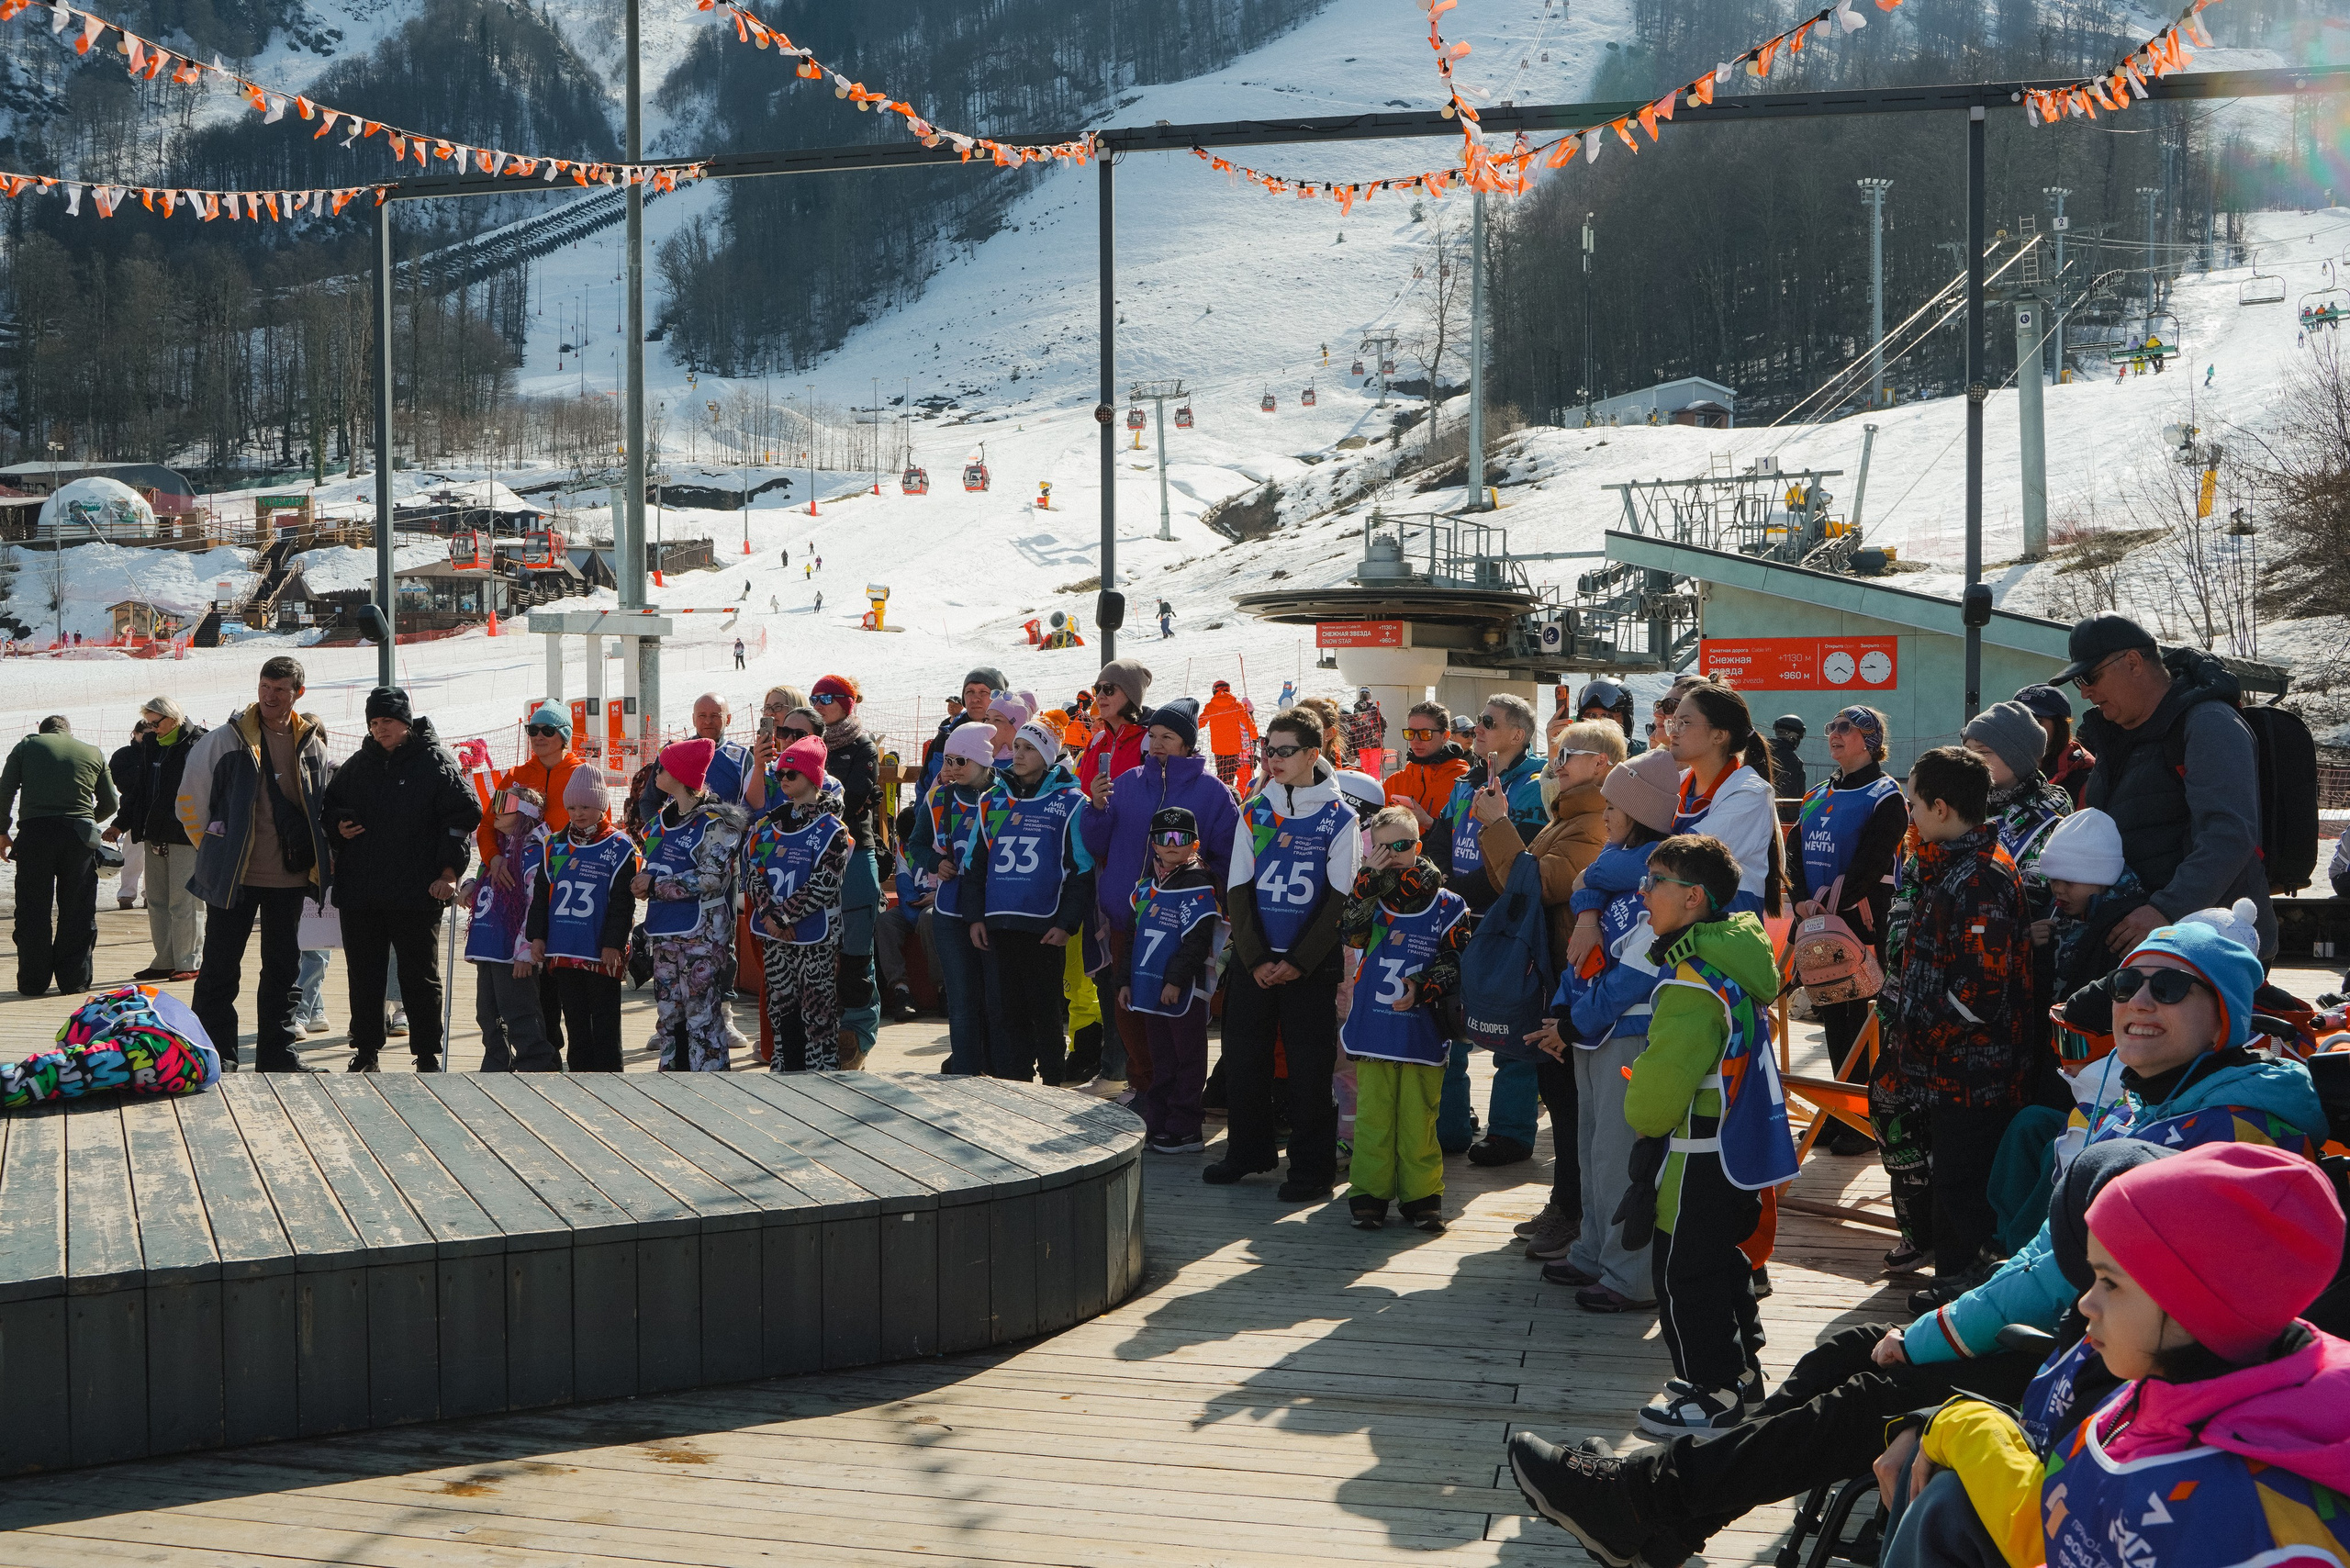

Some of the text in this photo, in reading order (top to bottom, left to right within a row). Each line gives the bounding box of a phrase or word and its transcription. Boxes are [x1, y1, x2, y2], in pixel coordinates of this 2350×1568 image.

[2058, 218, 2064, 227] 2
[1763, 458, 1768, 469] 1
[257, 497, 308, 507] ТЮБИНГ
[1708, 655, 1751, 665] Снежная
[1778, 654, 1803, 662] +1130
[1342, 793, 1363, 807] vex
[1808, 831, 1831, 842] ЛИГА
[994, 835, 1041, 873] 33
[1454, 846, 1480, 860] ЕЧТЫ
[1805, 841, 1835, 853] МЕЧТЫ
[767, 867, 796, 905] 21
[1256, 860, 1315, 905] 45
[475, 886, 494, 919] 9
[554, 879, 597, 918] 23
[1139, 928, 1167, 967] 7
[1407, 945, 1438, 953] ПРЕЗИДЕНТ
[1407, 949, 1430, 958] ГРАНТОВ
[1375, 957, 1424, 1004] 3
[1468, 1016, 1509, 1035] LEE COOPER
[1758, 1039, 1785, 1105] 1
[2064, 1534, 2094, 1568] ФОНД
